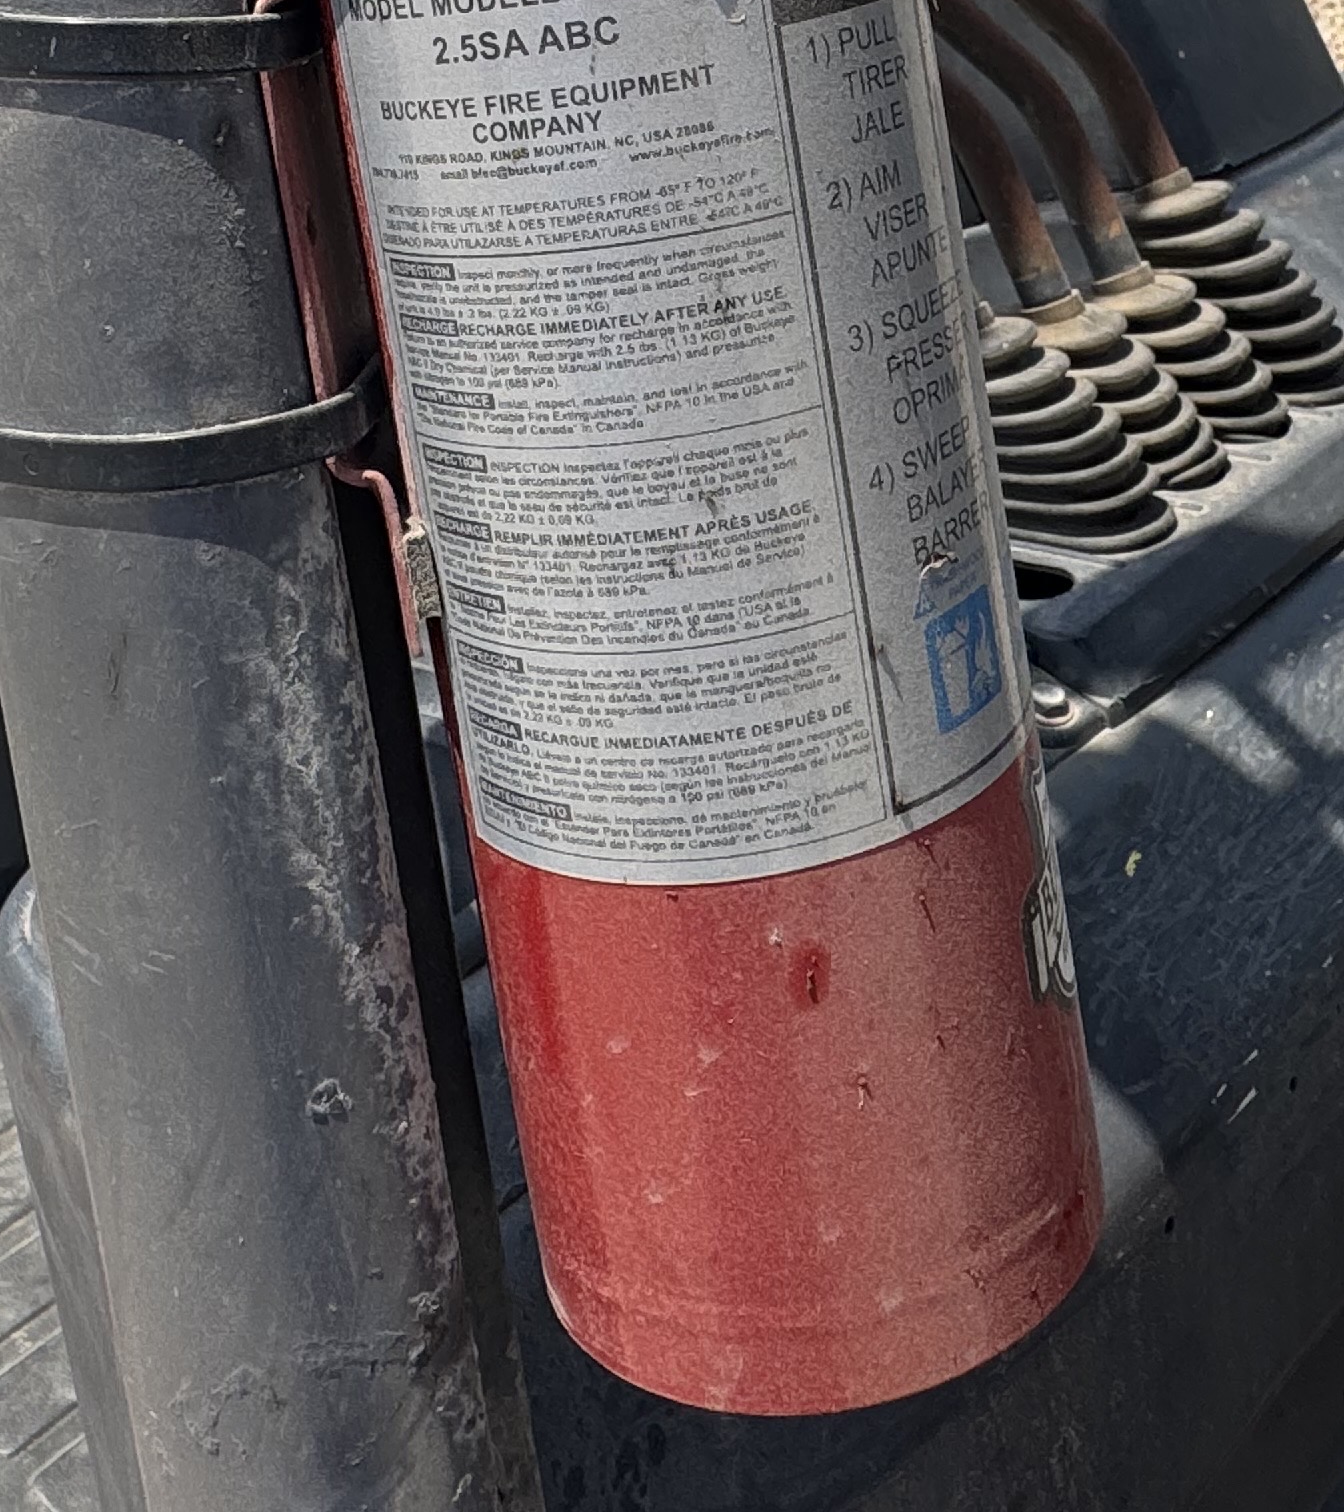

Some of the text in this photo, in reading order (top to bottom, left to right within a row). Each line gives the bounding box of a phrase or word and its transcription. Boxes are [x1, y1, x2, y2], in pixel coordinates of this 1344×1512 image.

[432, 16, 620, 65] 2.5SA ABC
[806, 15, 897, 70] 1) PULL
[379, 63, 716, 122] BUCKEYE FIRE EQUIPMENT
[842, 54, 908, 99] TIRER
[472, 109, 603, 144] COMPANY
[642, 129, 674, 144] USA
[851, 100, 906, 144] JALE
[481, 205, 494, 217] AT
[498, 193, 606, 216] TEMPERATURES
[610, 188, 651, 205] FROM
[826, 159, 902, 213] 2) AIM
[518, 215, 546, 231] DES
[665, 198, 685, 214] DE
[536, 221, 648, 246] TEMPERATURAS
[651, 213, 700, 233] ENTRE
[863, 192, 930, 242] VISER
[871, 224, 949, 288] APUNTE
[459, 322, 537, 337] RECHARGE
[540, 310, 649, 335] IMMEDIATELY
[654, 301, 709, 324] AFTER
[714, 294, 748, 315] ANY
[847, 319, 874, 355] 3)
[742, 383, 771, 398] USA
[868, 415, 971, 496] 4) SWEEP
[493, 530, 553, 547] REMPLIR
[557, 525, 690, 547] IMMÉDIATEMENT
[694, 514, 752, 537] APRÈS
[912, 490, 989, 565] BARRER
[523, 699, 854, 750] RECARGUE INMEDIATAMENTE DESPUÉS DE
